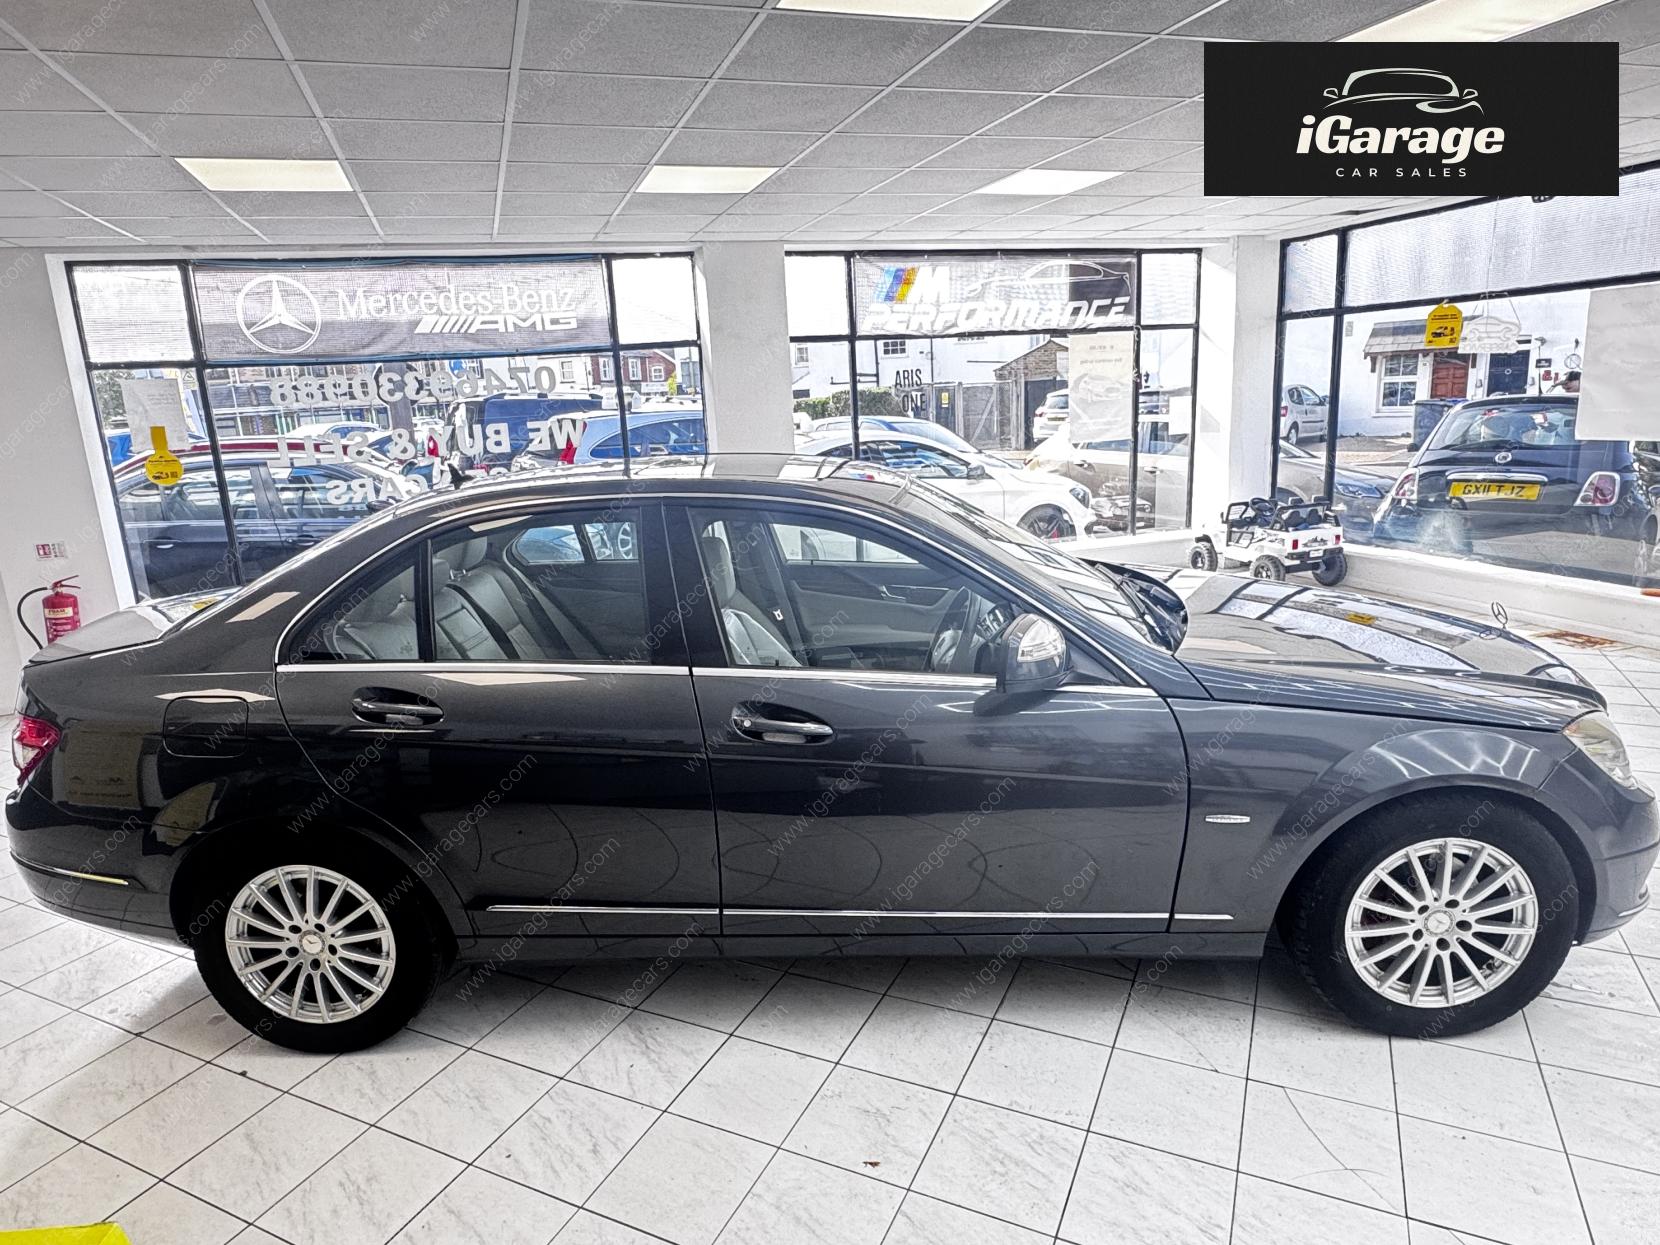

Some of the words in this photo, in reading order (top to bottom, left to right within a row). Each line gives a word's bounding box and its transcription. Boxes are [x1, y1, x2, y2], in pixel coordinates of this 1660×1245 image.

[336, 283, 576, 319] Mercedes-Benz
[861, 296, 1131, 332] PERFORMANCE
[894, 368, 923, 389] ARIS
[902, 393, 926, 413] ONE
